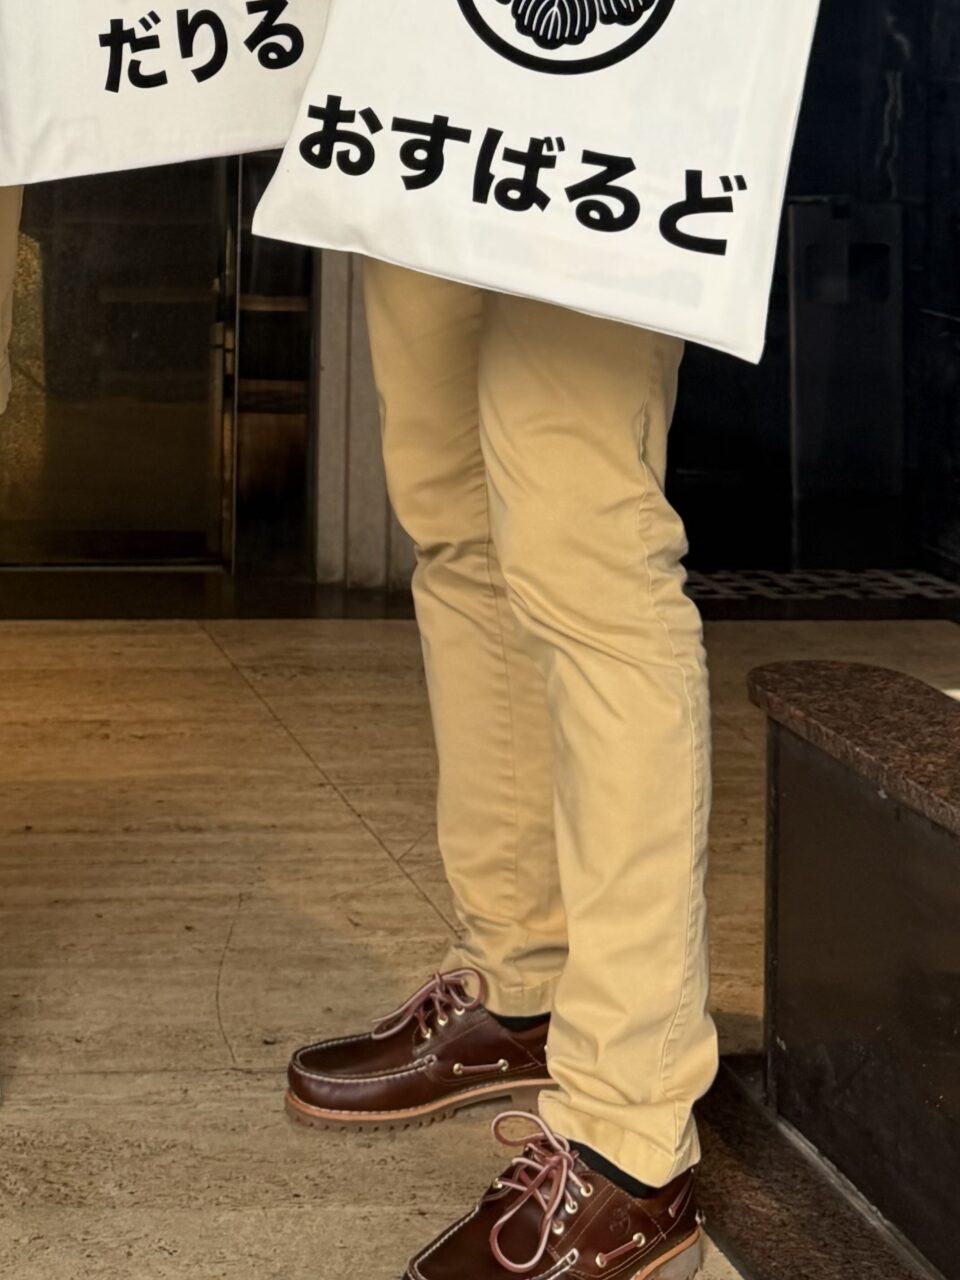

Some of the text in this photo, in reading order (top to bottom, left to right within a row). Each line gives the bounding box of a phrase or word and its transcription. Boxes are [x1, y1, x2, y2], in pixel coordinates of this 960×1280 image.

[298, 94, 747, 256] おすばるど
